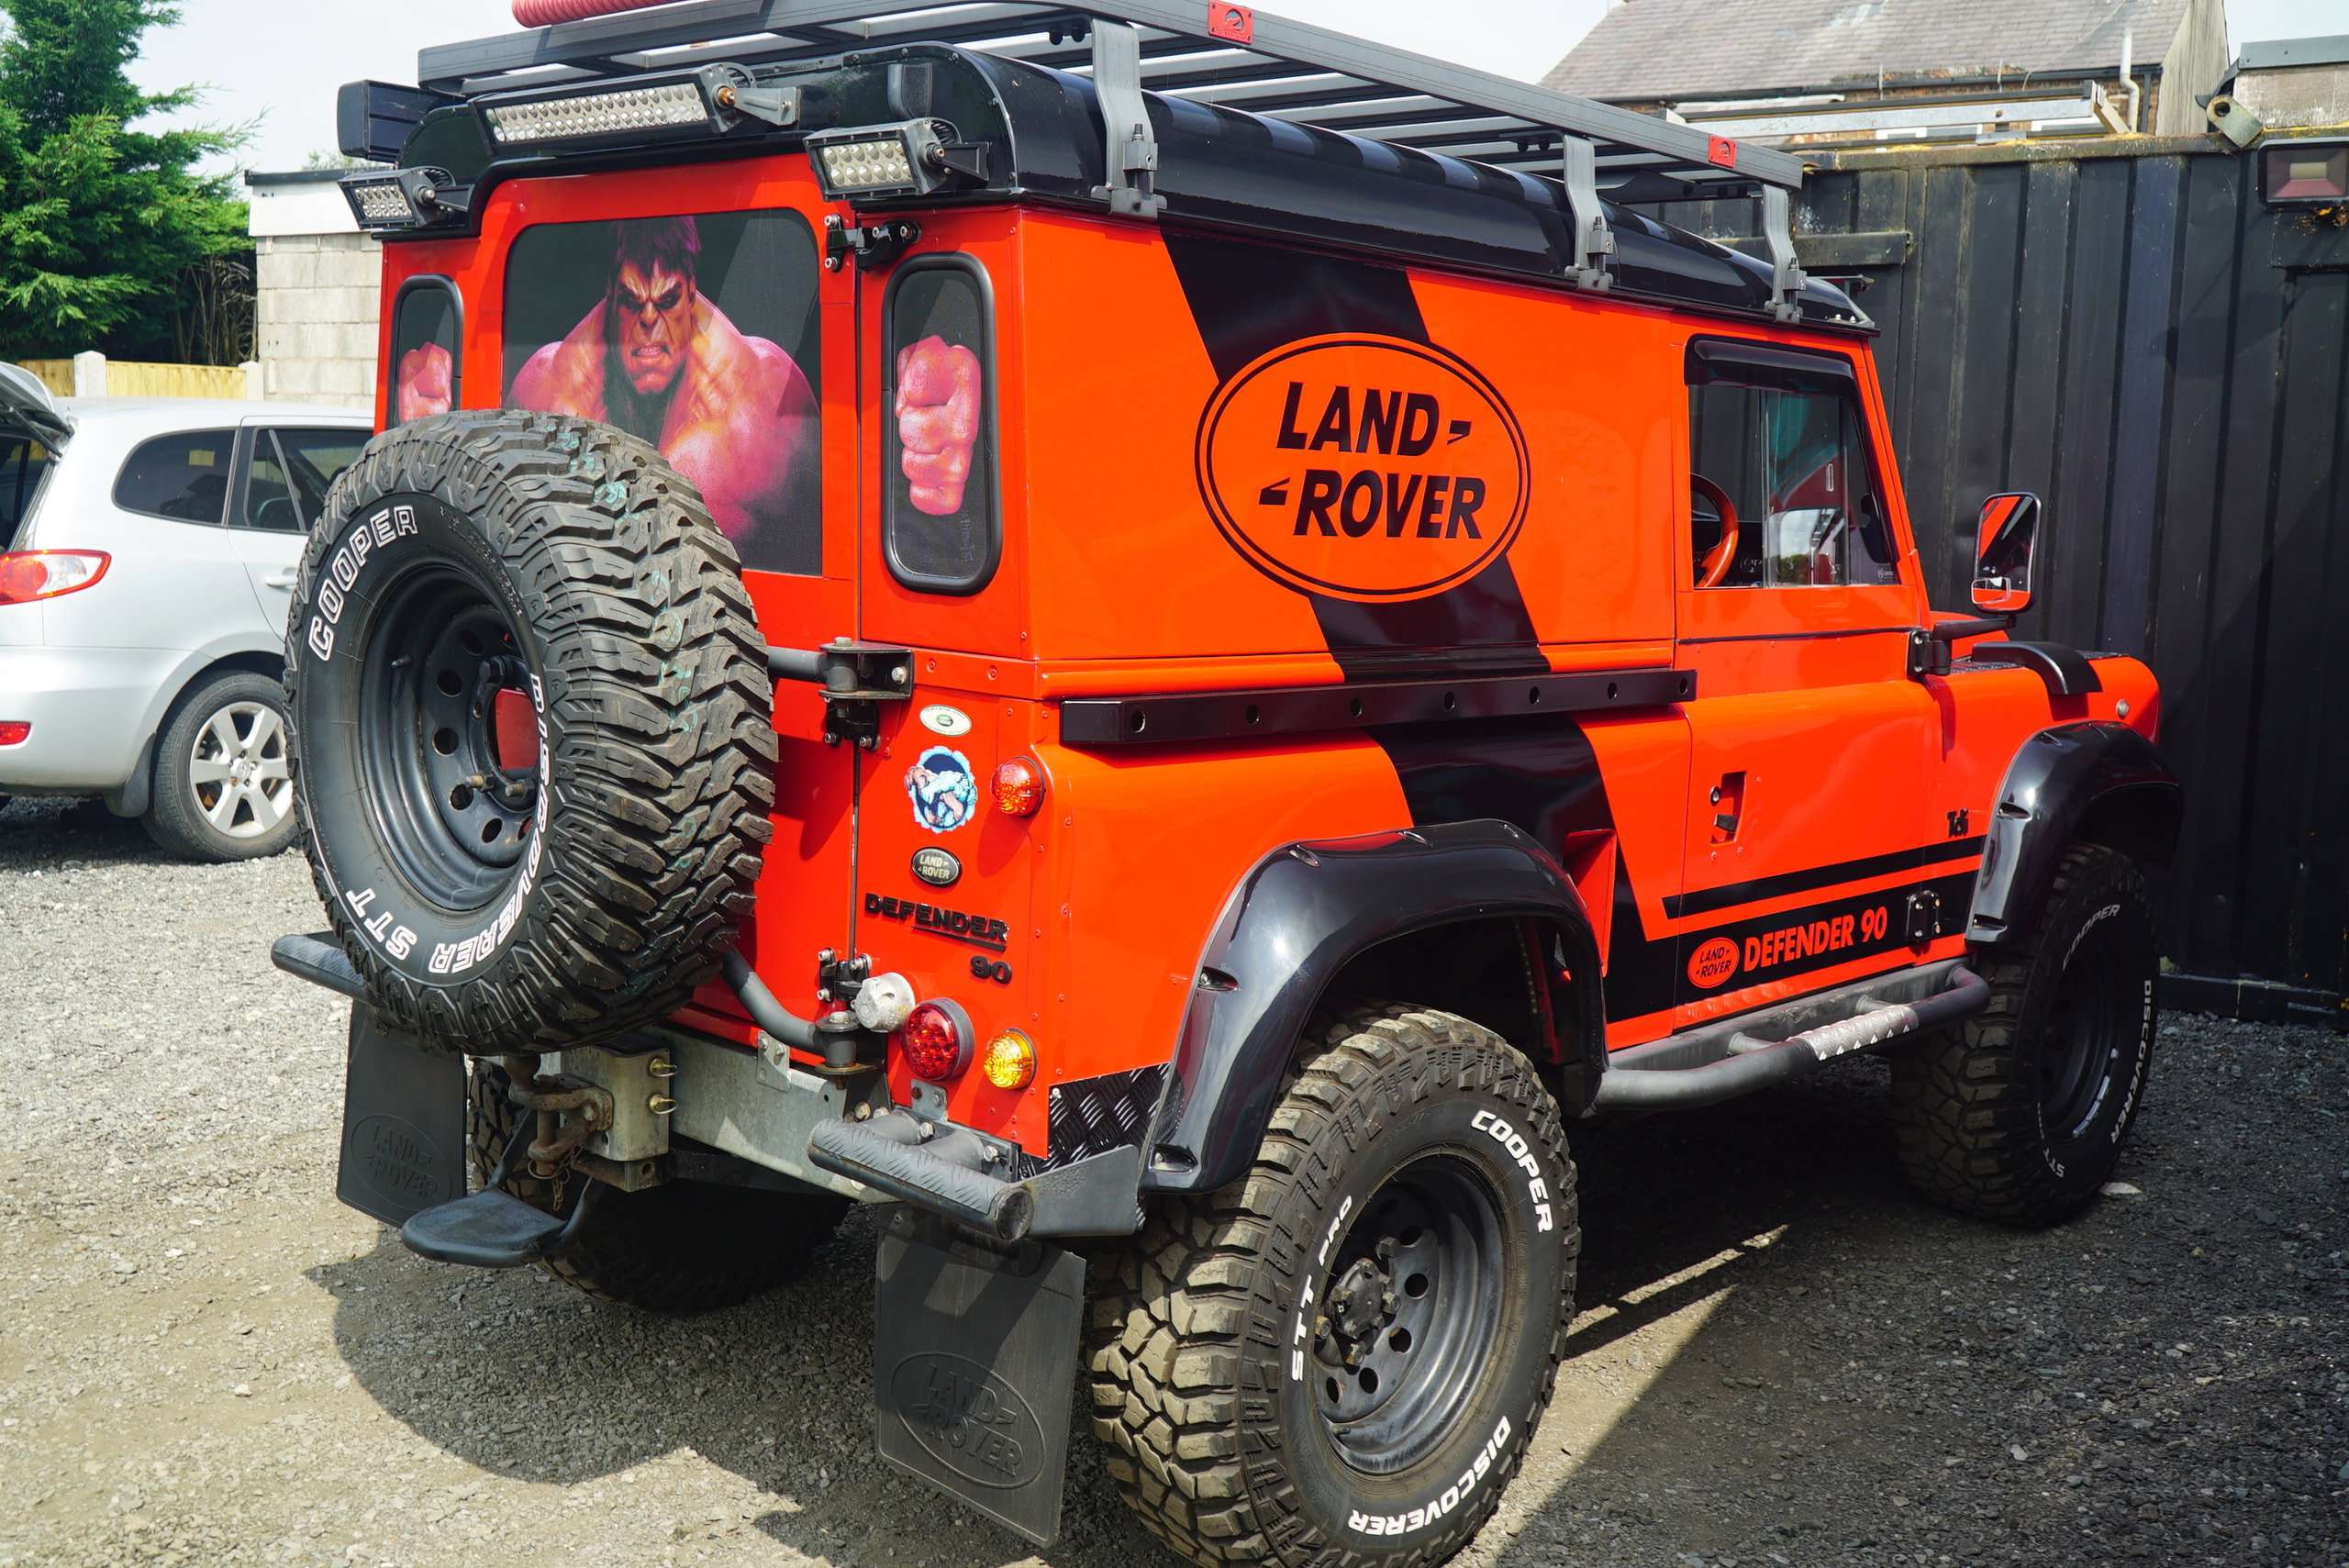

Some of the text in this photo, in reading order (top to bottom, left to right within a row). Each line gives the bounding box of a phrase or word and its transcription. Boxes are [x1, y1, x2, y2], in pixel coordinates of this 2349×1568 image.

[308, 505, 418, 662] COOPER
[428, 673, 550, 974] DISCOVERER
[345, 888, 418, 960] STT
[864, 893, 1010, 943] DEFENDER
[969, 955, 1013, 984] 90
[1744, 906, 1887, 972] DEFENDER 90
[2110, 980, 2152, 1144] DISCOVERER
[1471, 1109, 1553, 1233] COOPER
[1291, 1195, 1353, 1381] STT PRO
[1349, 1416, 1512, 1536] DISCOVERER
